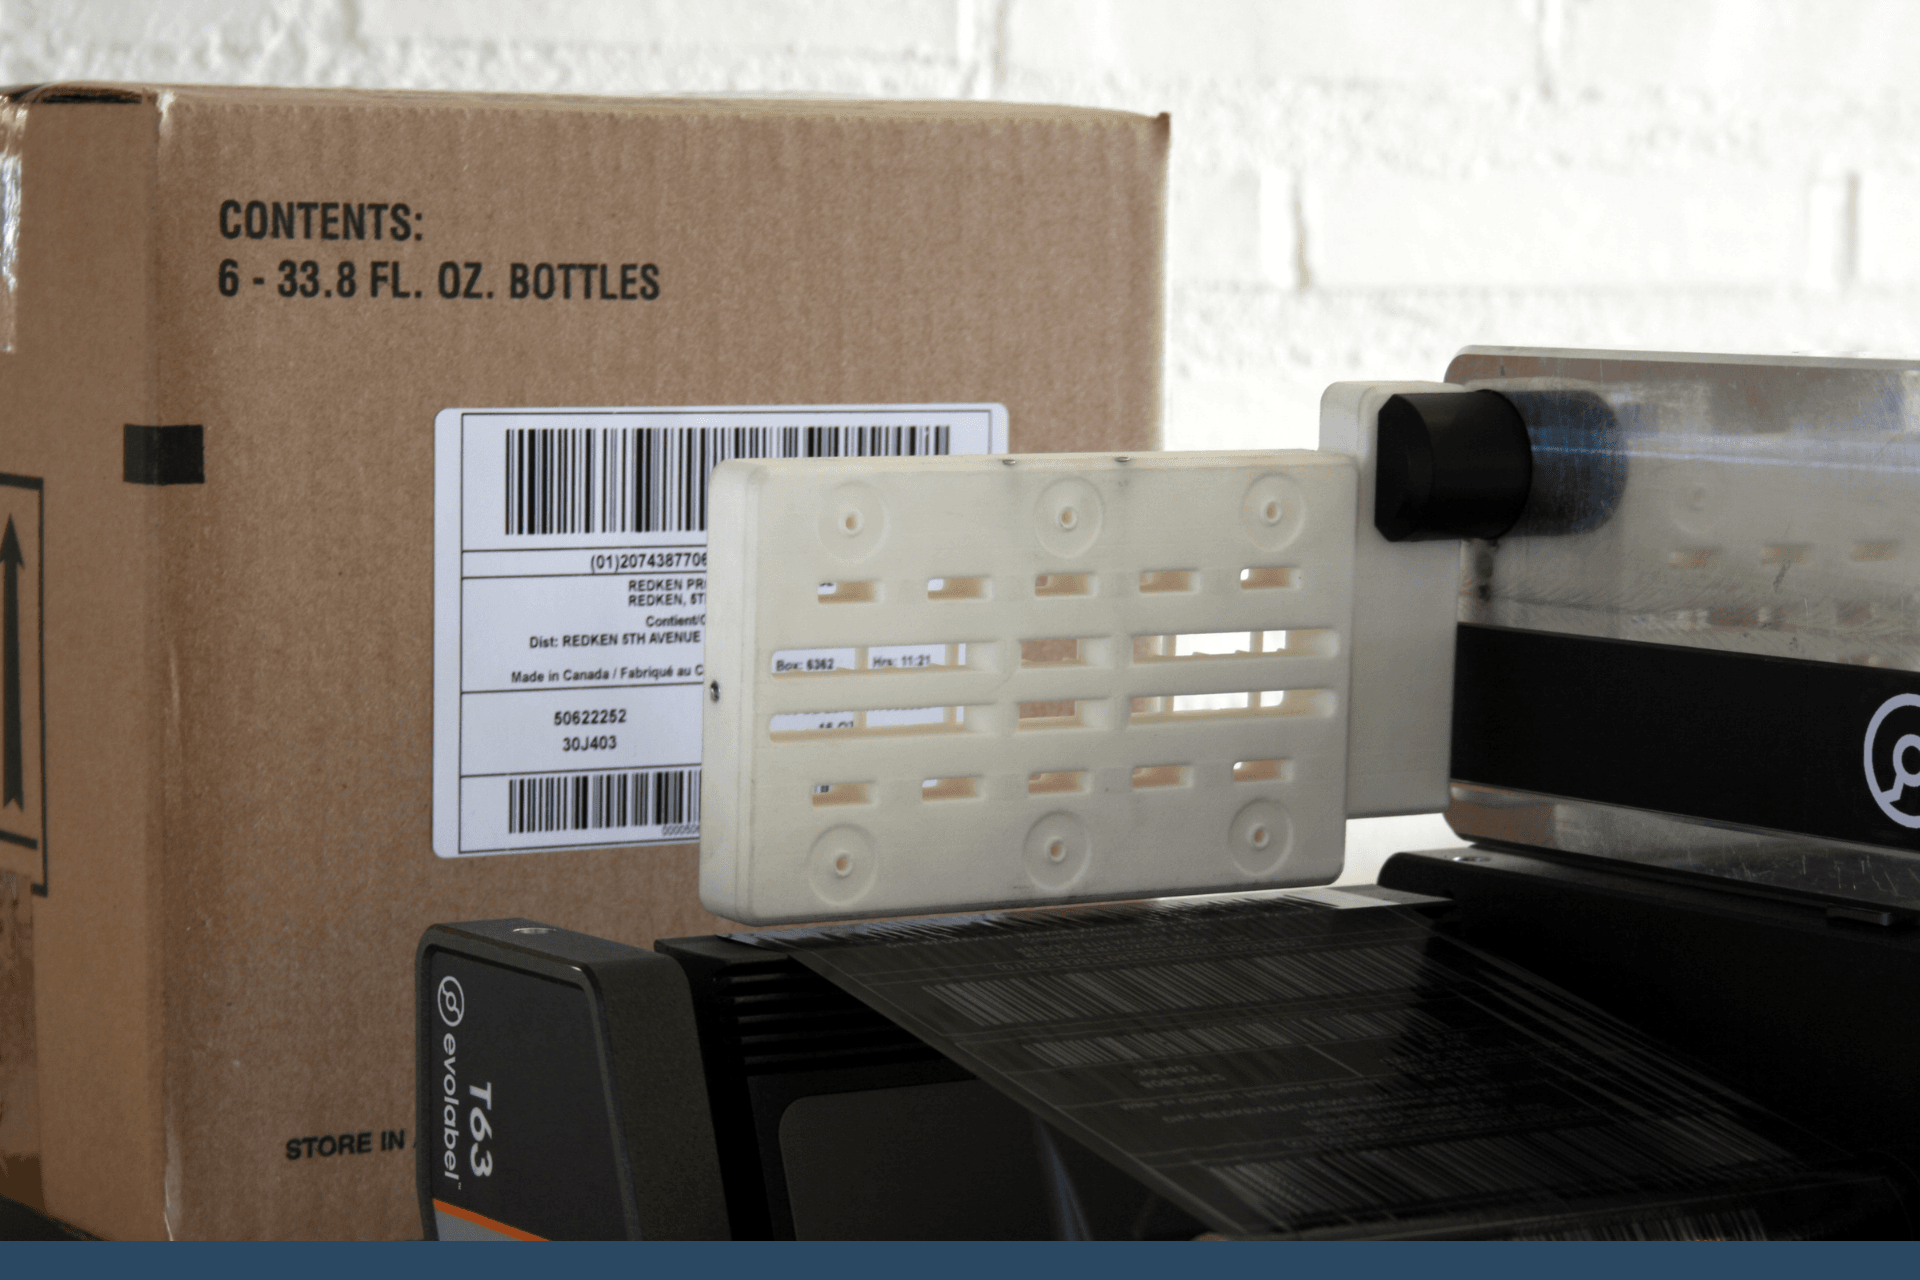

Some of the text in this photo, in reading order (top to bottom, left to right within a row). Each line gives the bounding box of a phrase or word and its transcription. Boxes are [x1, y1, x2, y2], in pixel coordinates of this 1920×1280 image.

[219, 199, 423, 241] CONTENTS:
[218, 258, 661, 301] 6 - 33.8 FL. OZ. BOTTLES
[628, 578, 683, 593] REDKEN
[628, 593, 687, 607] REDKEN,
[529, 630, 701, 649] Dist: REDKEN 5TH AVENUE
[511, 669, 545, 684] Made
[548, 669, 560, 682] in
[563, 667, 610, 682] Canada
[620, 665, 674, 681] Fabriqué
[677, 665, 692, 677] au
[554, 708, 627, 727] 50622252
[562, 734, 618, 752] 30J403
[443, 1033, 460, 1180] evolabel
[469, 1081, 494, 1178] T63
[285, 1131, 373, 1161] STORE
[381, 1127, 406, 1151] IN
